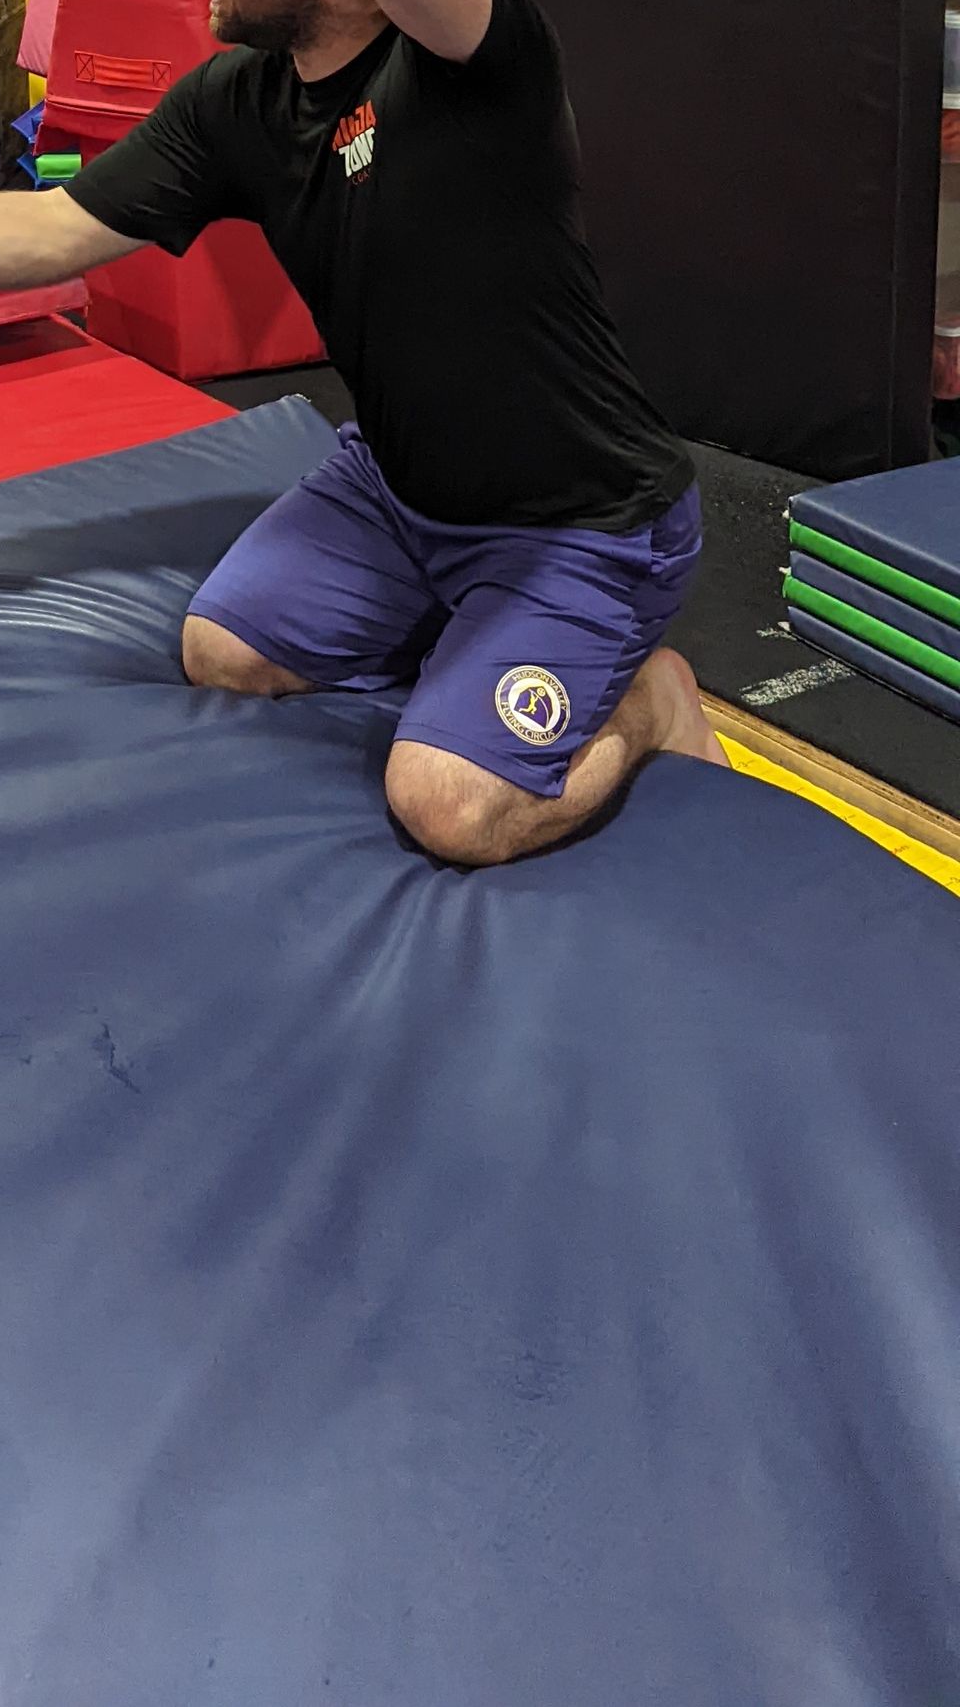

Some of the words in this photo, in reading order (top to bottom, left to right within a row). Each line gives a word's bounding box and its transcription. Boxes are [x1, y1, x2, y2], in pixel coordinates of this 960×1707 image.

[511, 670, 550, 683] HUDSON
[548, 680, 568, 711] VALLEY
[501, 701, 525, 734] FLYING
[525, 729, 555, 742] CIRCUS
